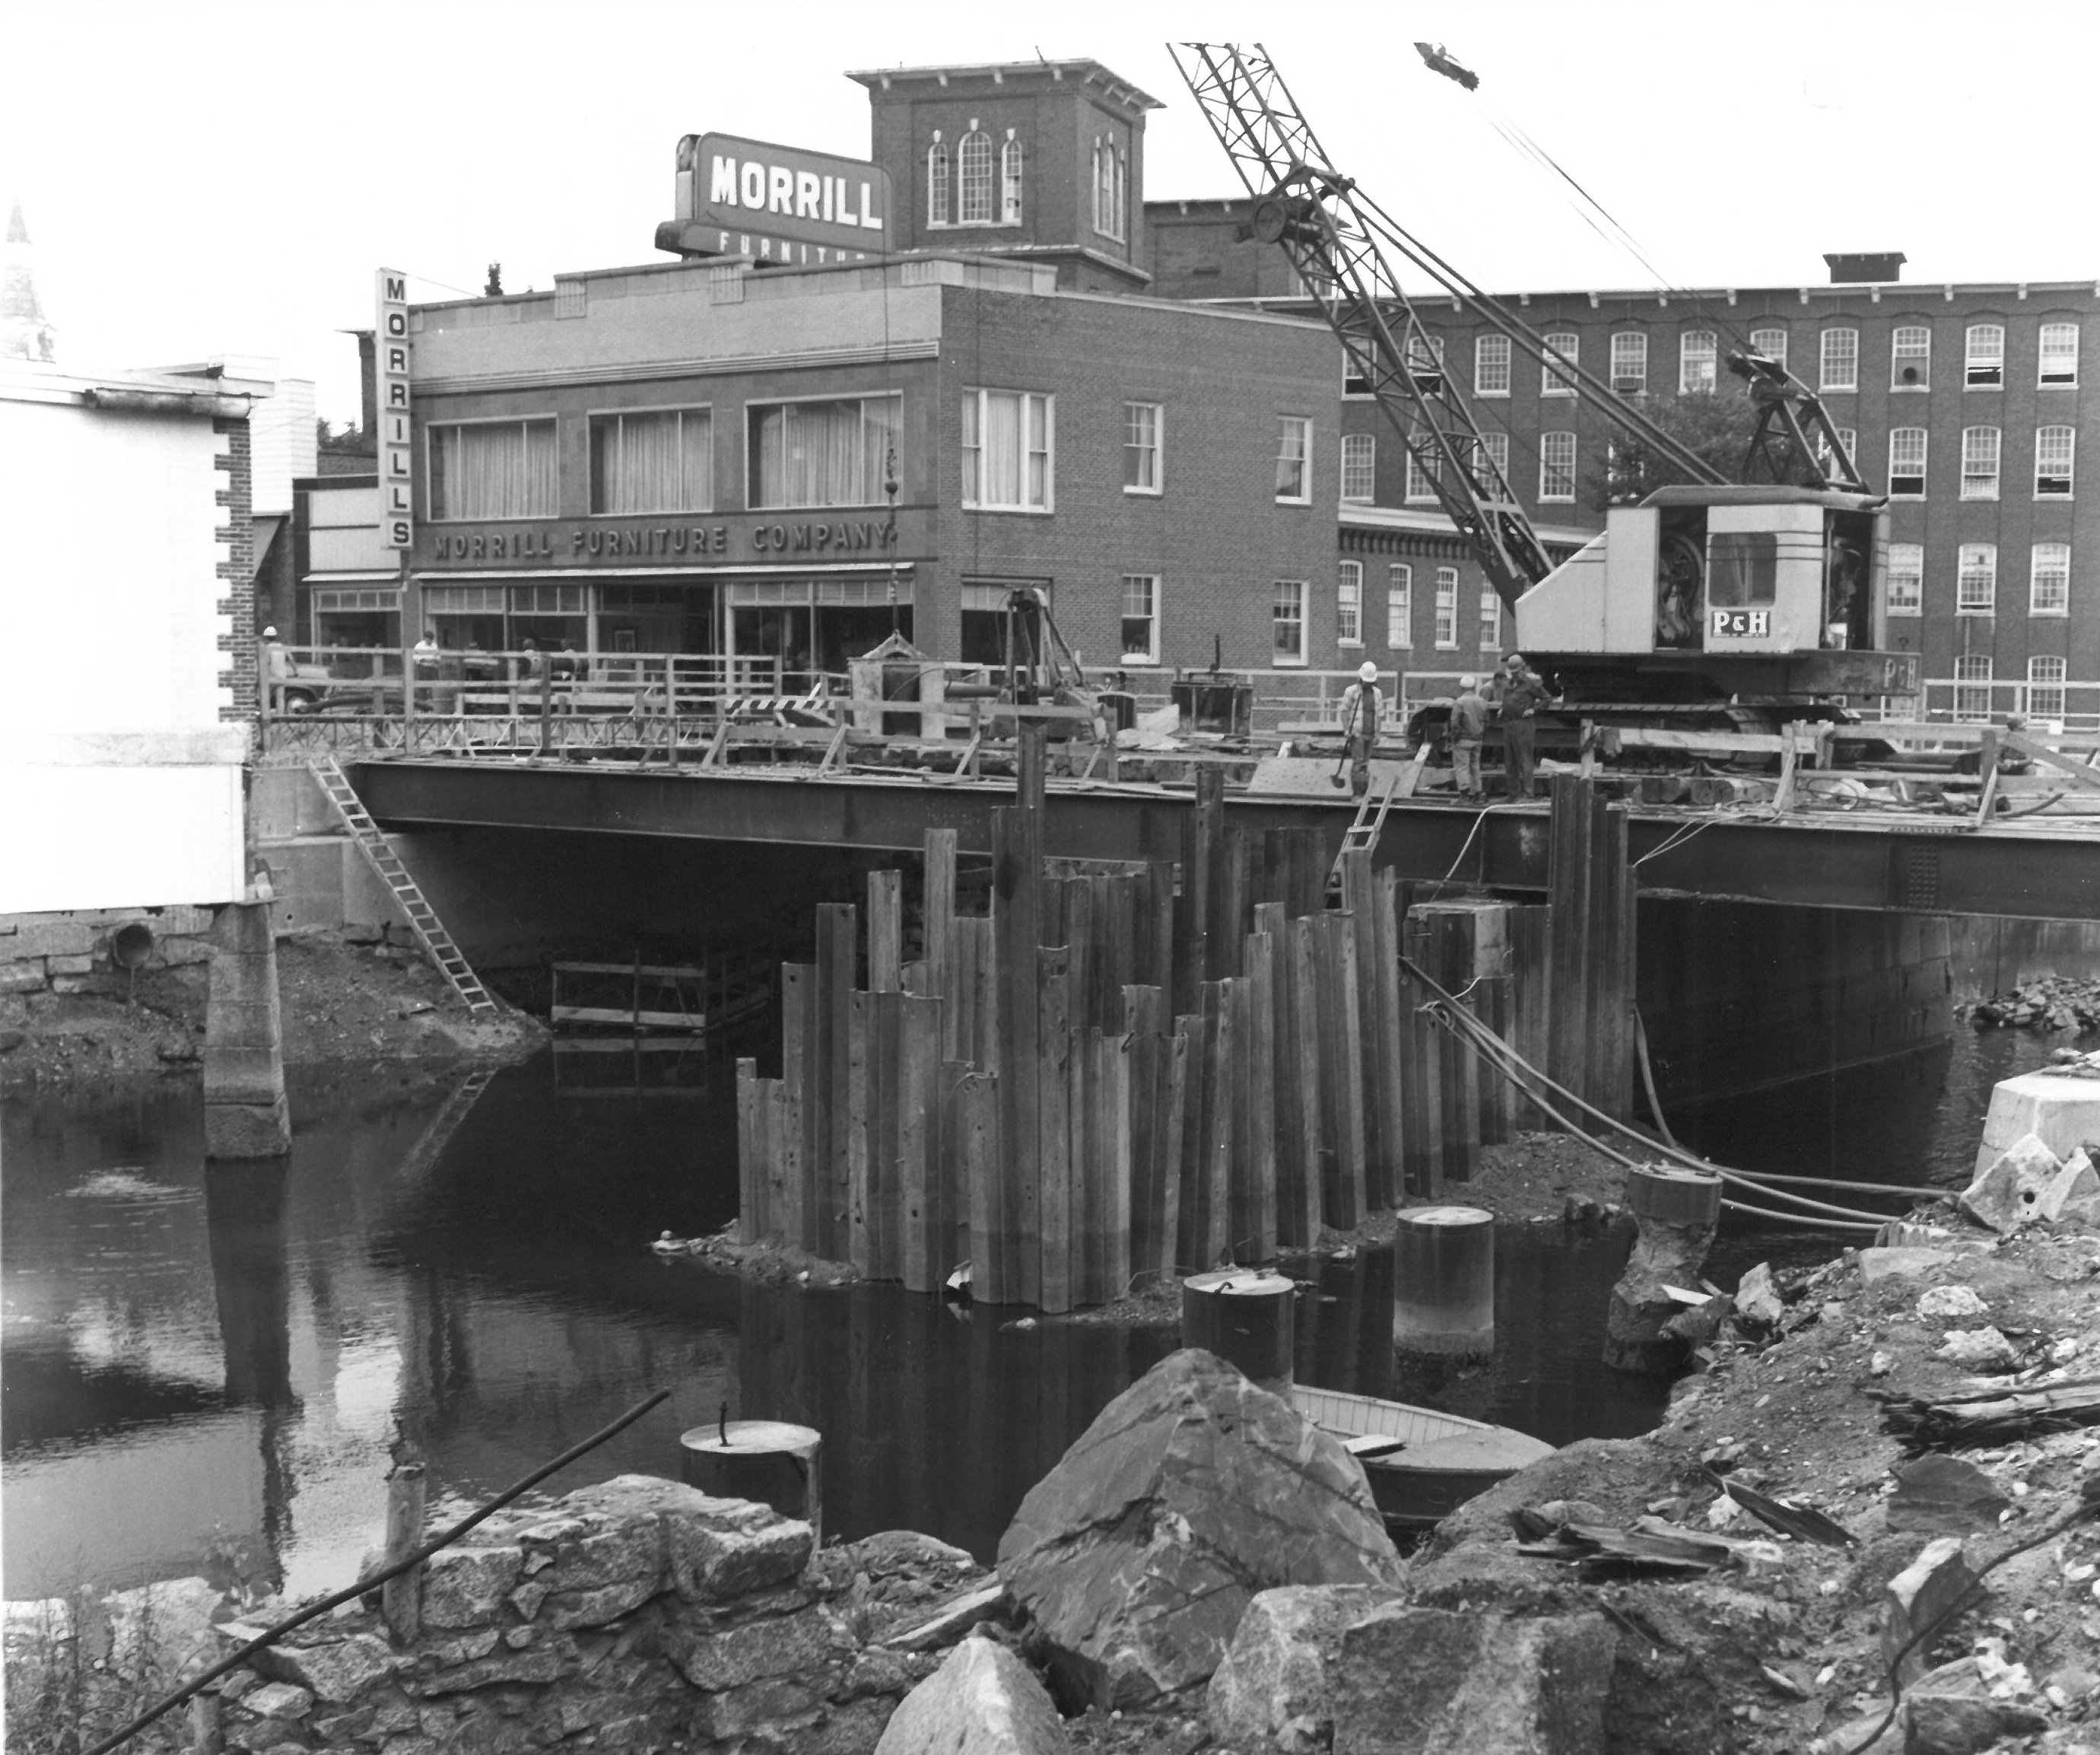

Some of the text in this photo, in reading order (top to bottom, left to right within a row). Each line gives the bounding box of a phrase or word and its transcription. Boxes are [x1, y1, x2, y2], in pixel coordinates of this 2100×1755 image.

[710, 154, 882, 230] MORRILL
[386, 278, 409, 543] MORRILLS
[434, 523, 888, 561] MORRILL FURNITURE COMPANY
